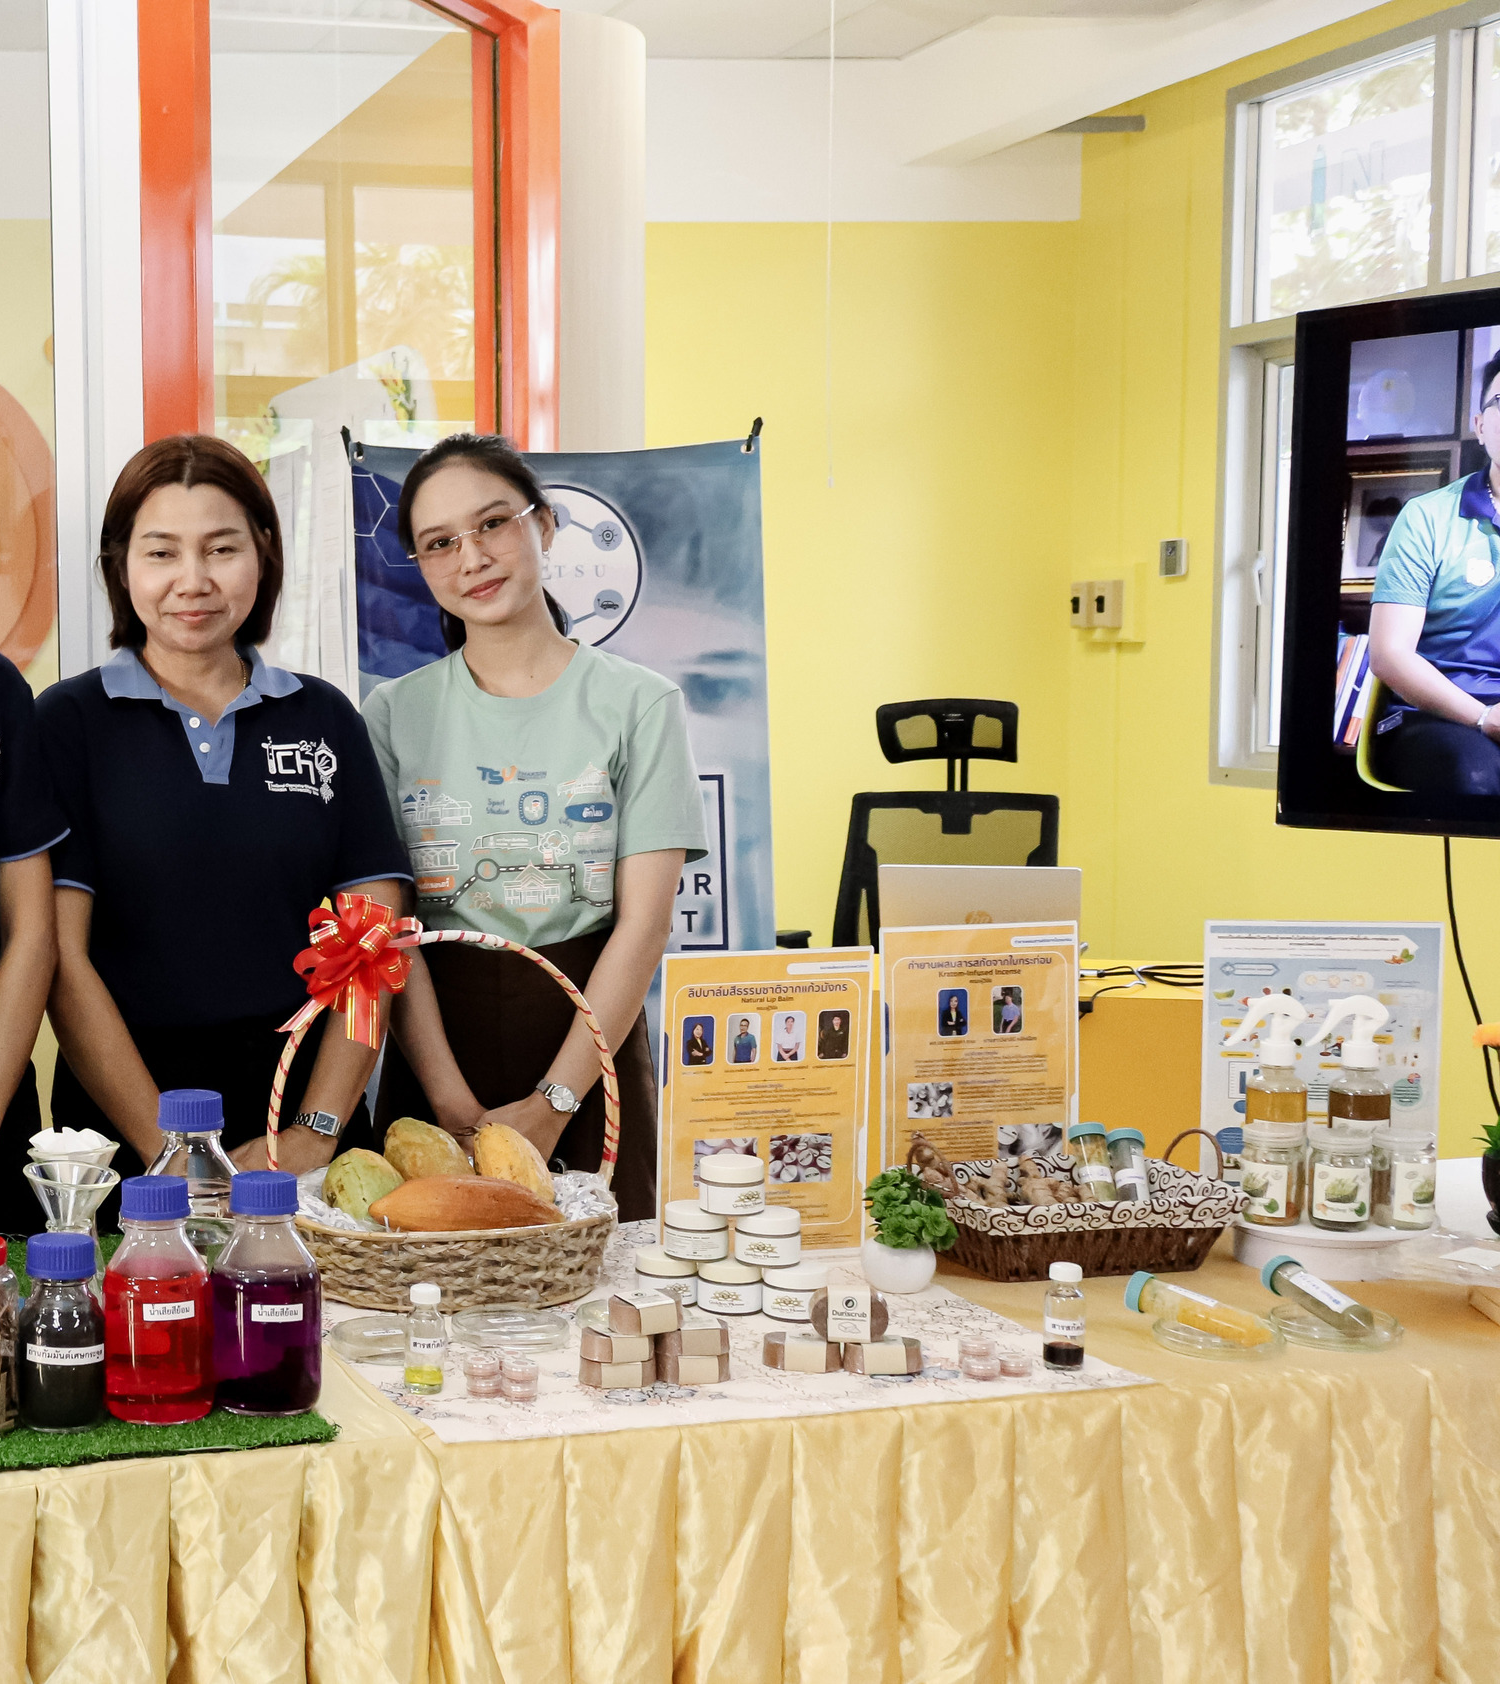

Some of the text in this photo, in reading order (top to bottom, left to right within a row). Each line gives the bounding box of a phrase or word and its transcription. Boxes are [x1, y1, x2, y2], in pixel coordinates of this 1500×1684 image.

[476, 765, 518, 785] TSU
[688, 981, 848, 999] ลิปบาล์มสีธรรมชาติจากแก้วมังกร
[149, 1303, 190, 1316] น้ำเสียสีย้อม
[258, 1305, 298, 1318] น้ำเสียสีย้อม
[832, 1309, 867, 1318] Duriscrub
